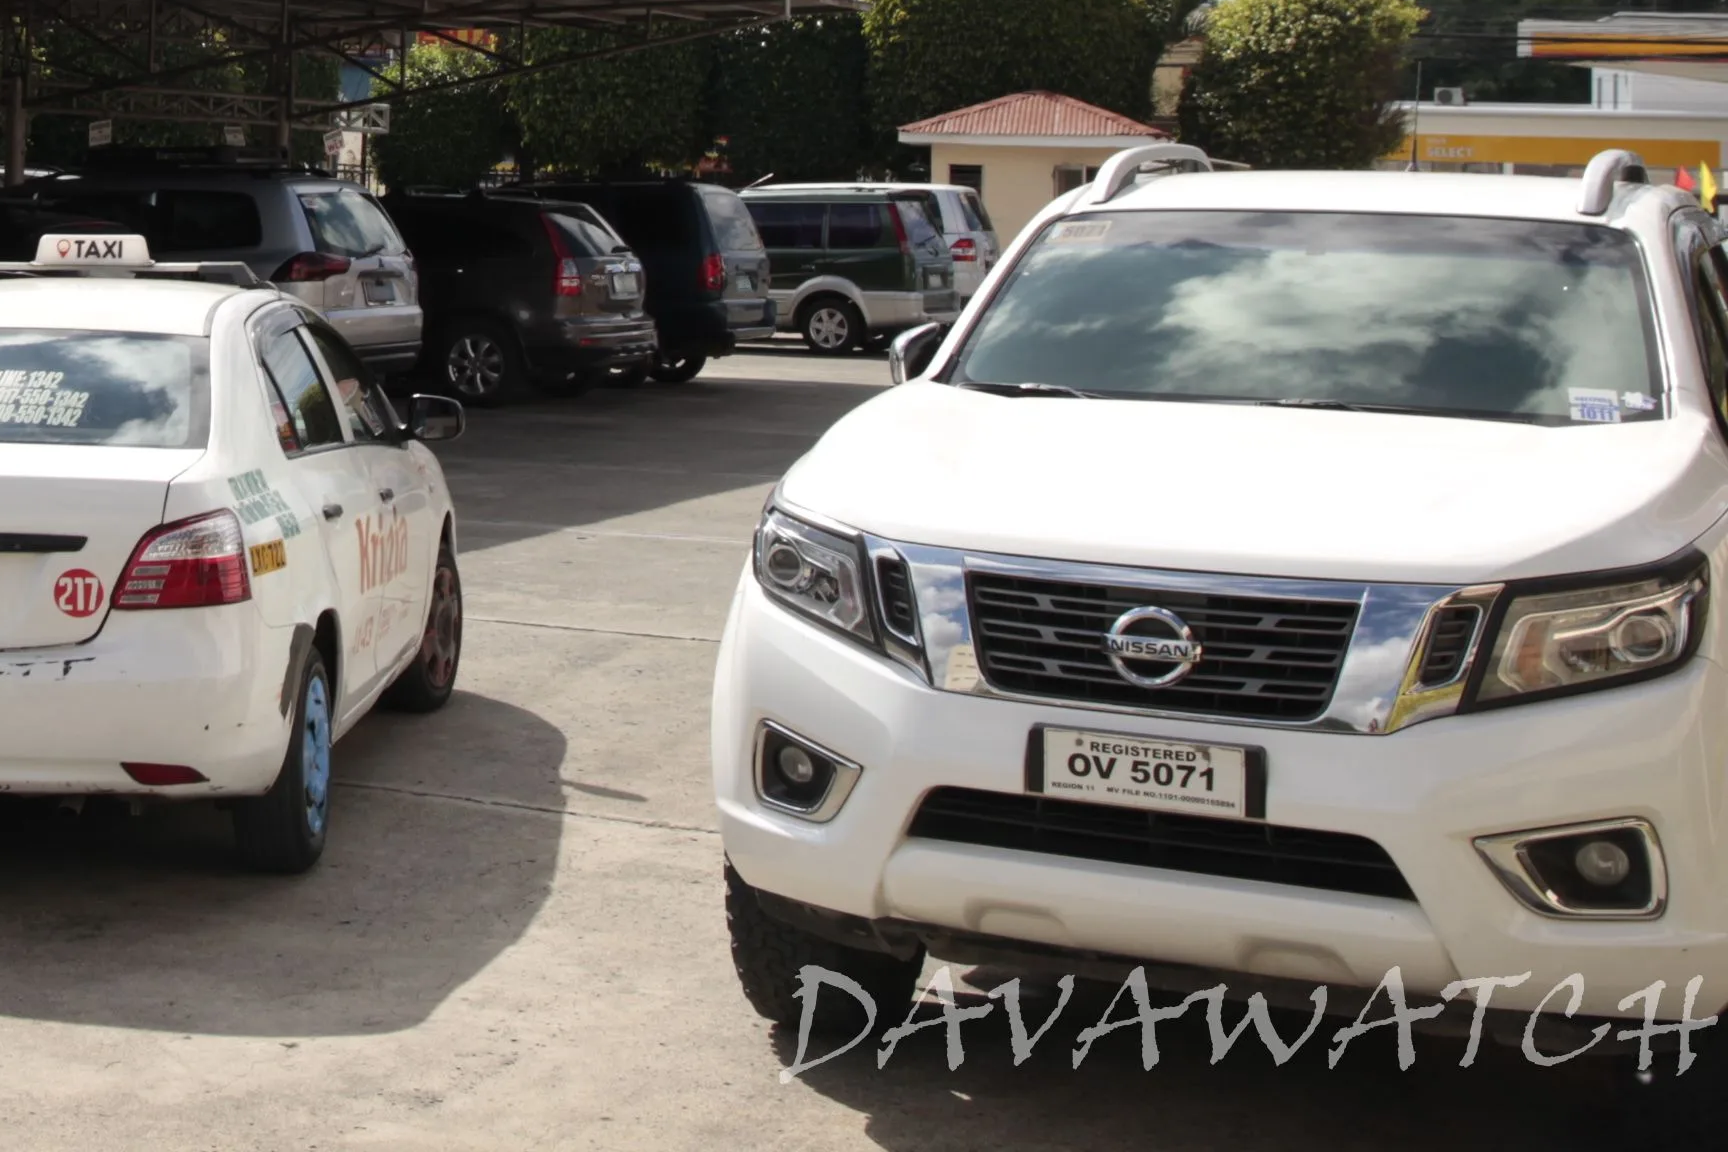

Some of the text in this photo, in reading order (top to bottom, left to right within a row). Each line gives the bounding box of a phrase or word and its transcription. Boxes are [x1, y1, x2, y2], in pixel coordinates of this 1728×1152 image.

[74, 240, 123, 259] TAXI
[28, 371, 64, 389] 1342
[57, 576, 101, 612] 217
[1110, 639, 1189, 657] NISSAN
[1090, 741, 1197, 762] REGISTERED
[1067, 752, 1215, 792] OV 5071
[1051, 781, 1083, 791] REGION
[1122, 788, 1141, 797] FILE
